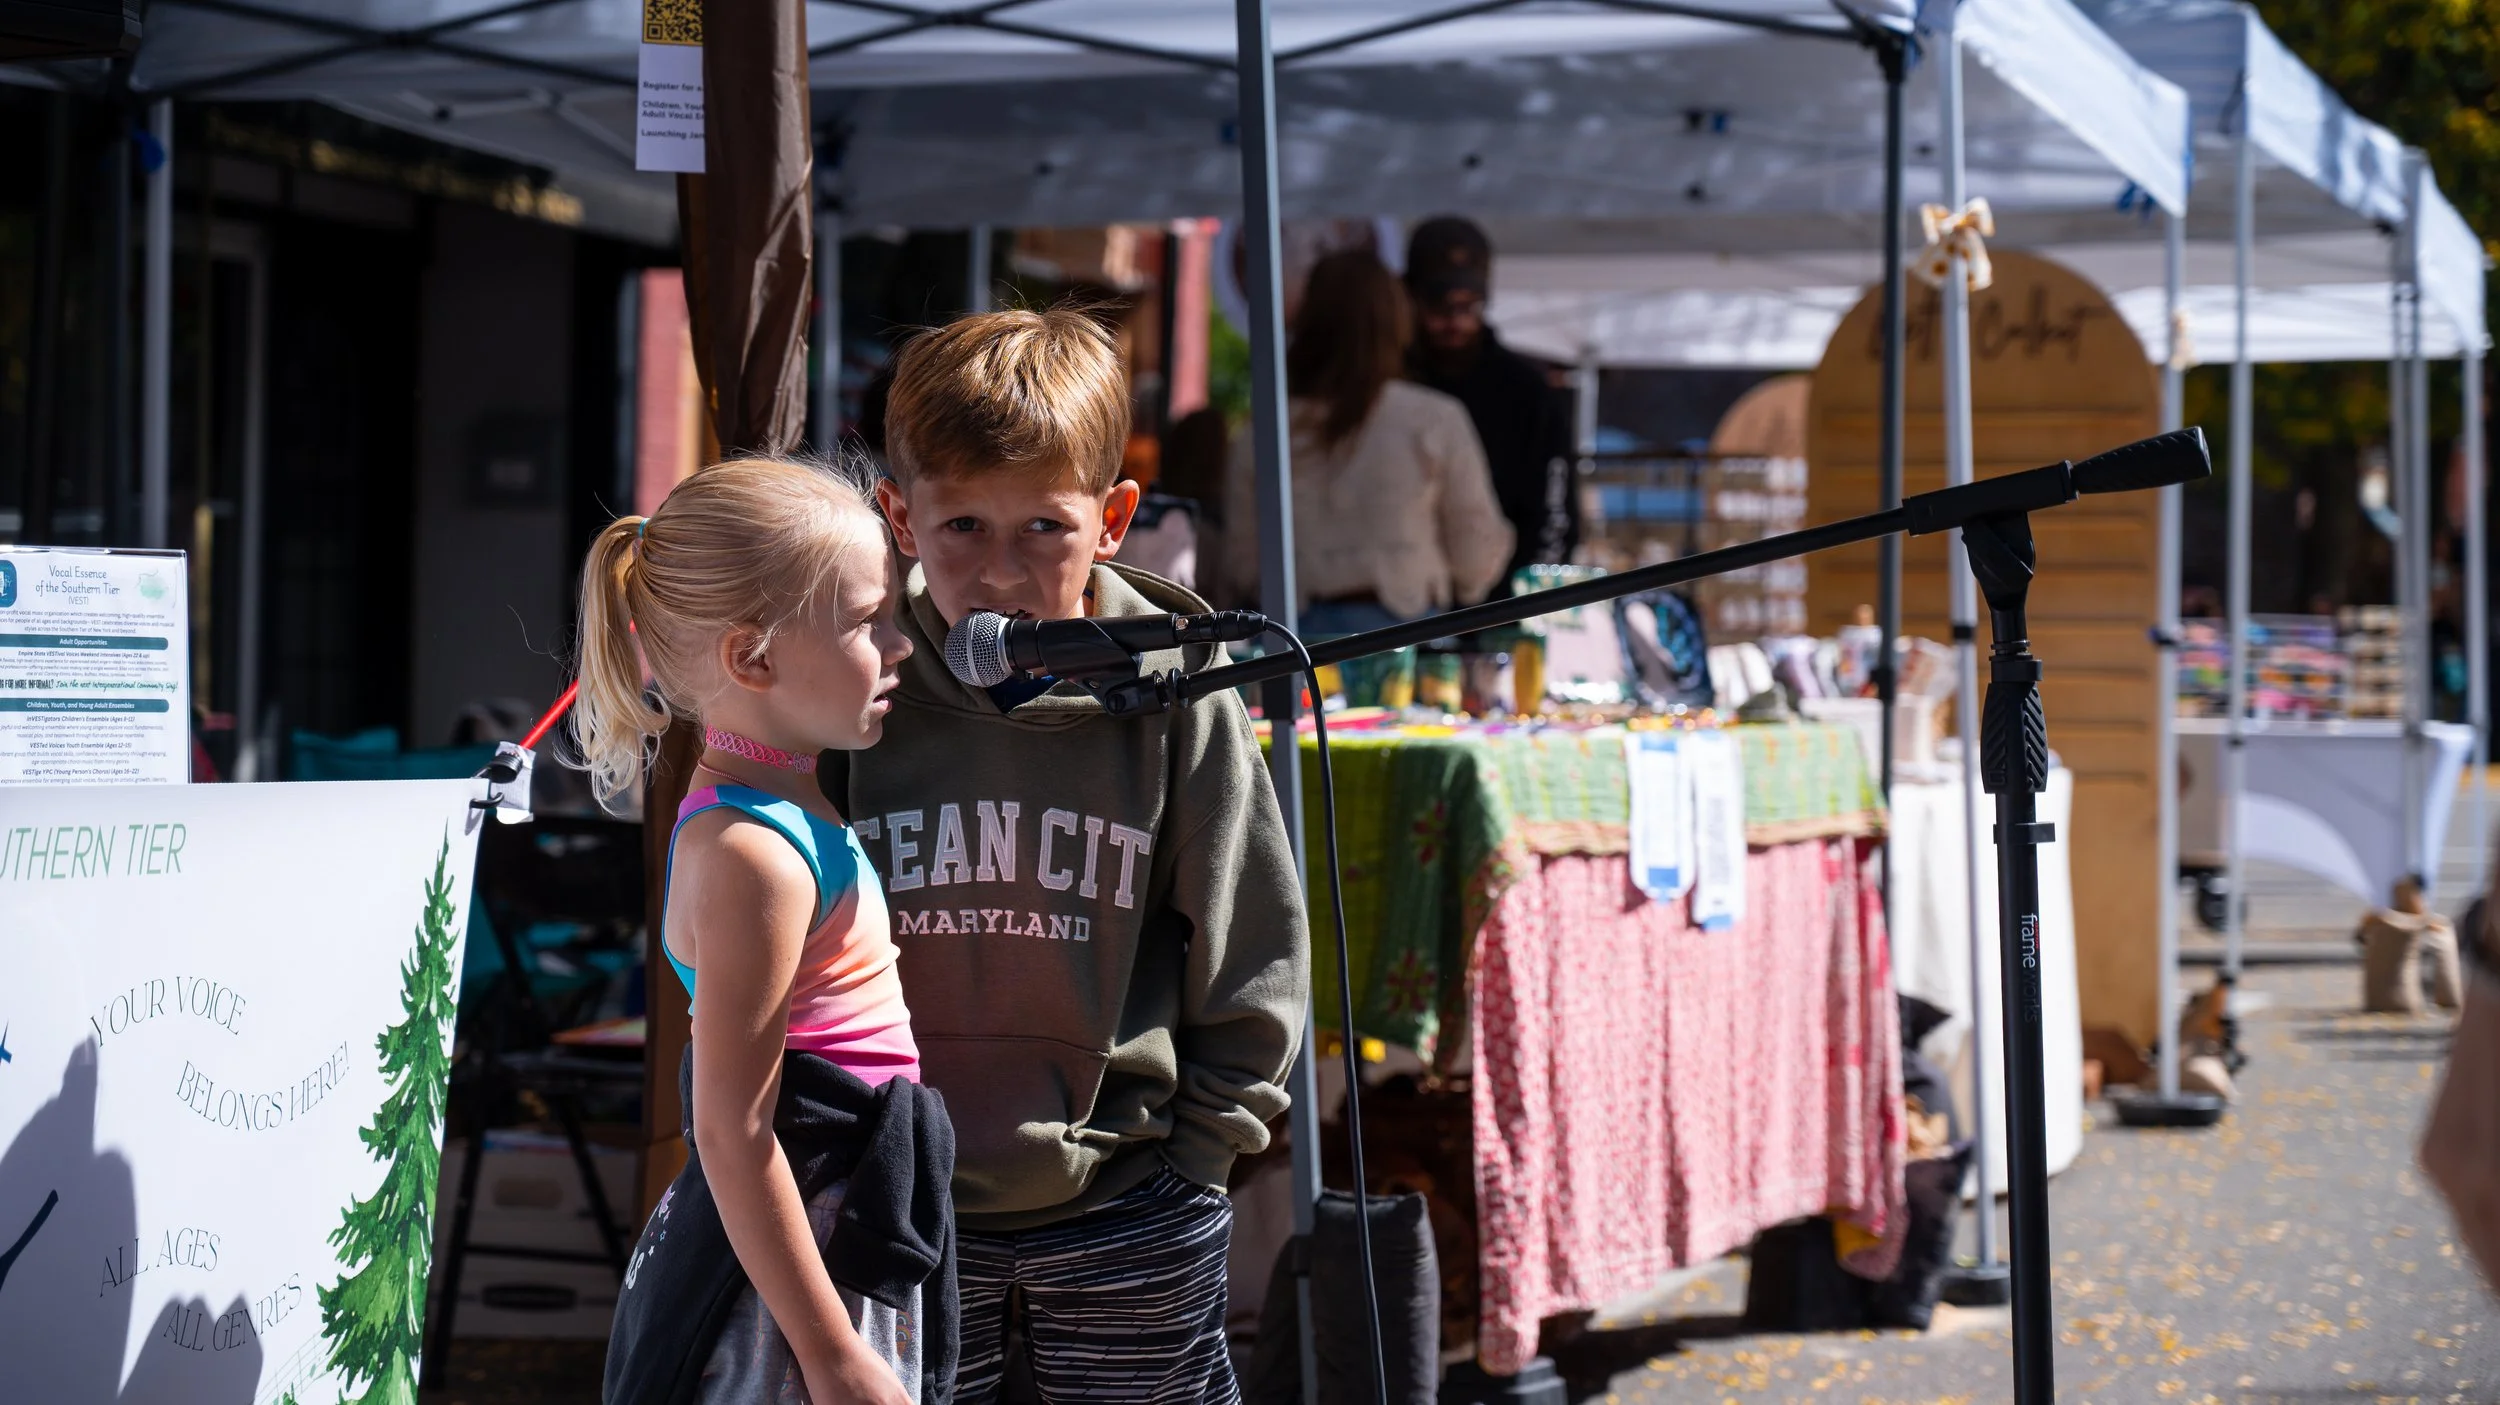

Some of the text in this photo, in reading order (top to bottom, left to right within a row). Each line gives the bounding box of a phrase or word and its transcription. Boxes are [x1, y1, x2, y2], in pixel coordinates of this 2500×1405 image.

[643, 81, 679, 91] Register
[682, 83, 694, 91] for
[642, 110, 666, 118] Adult
[669, 111, 693, 119] Vocal
[641, 128, 687, 140] Launching
[49, 564, 107, 579] Vocal Essence
[35, 580, 120, 597] of the Southern Tier
[68, 595, 89, 605] (VEST)
[74, 638, 108, 647] Opportunities
[5, 679, 14, 689] FOR
[26, 701, 50, 709] Children,
[79, 702, 93, 710] Young
[127, 823, 187, 876] TIER
[898, 908, 1091, 942] MARYLAND
[90, 976, 247, 1048] YOUR VOICE
[176, 1041, 350, 1131] BELONGS HERE!
[99, 1227, 221, 1297] ALL AGES
[163, 1273, 303, 1352] ALL GENRES
